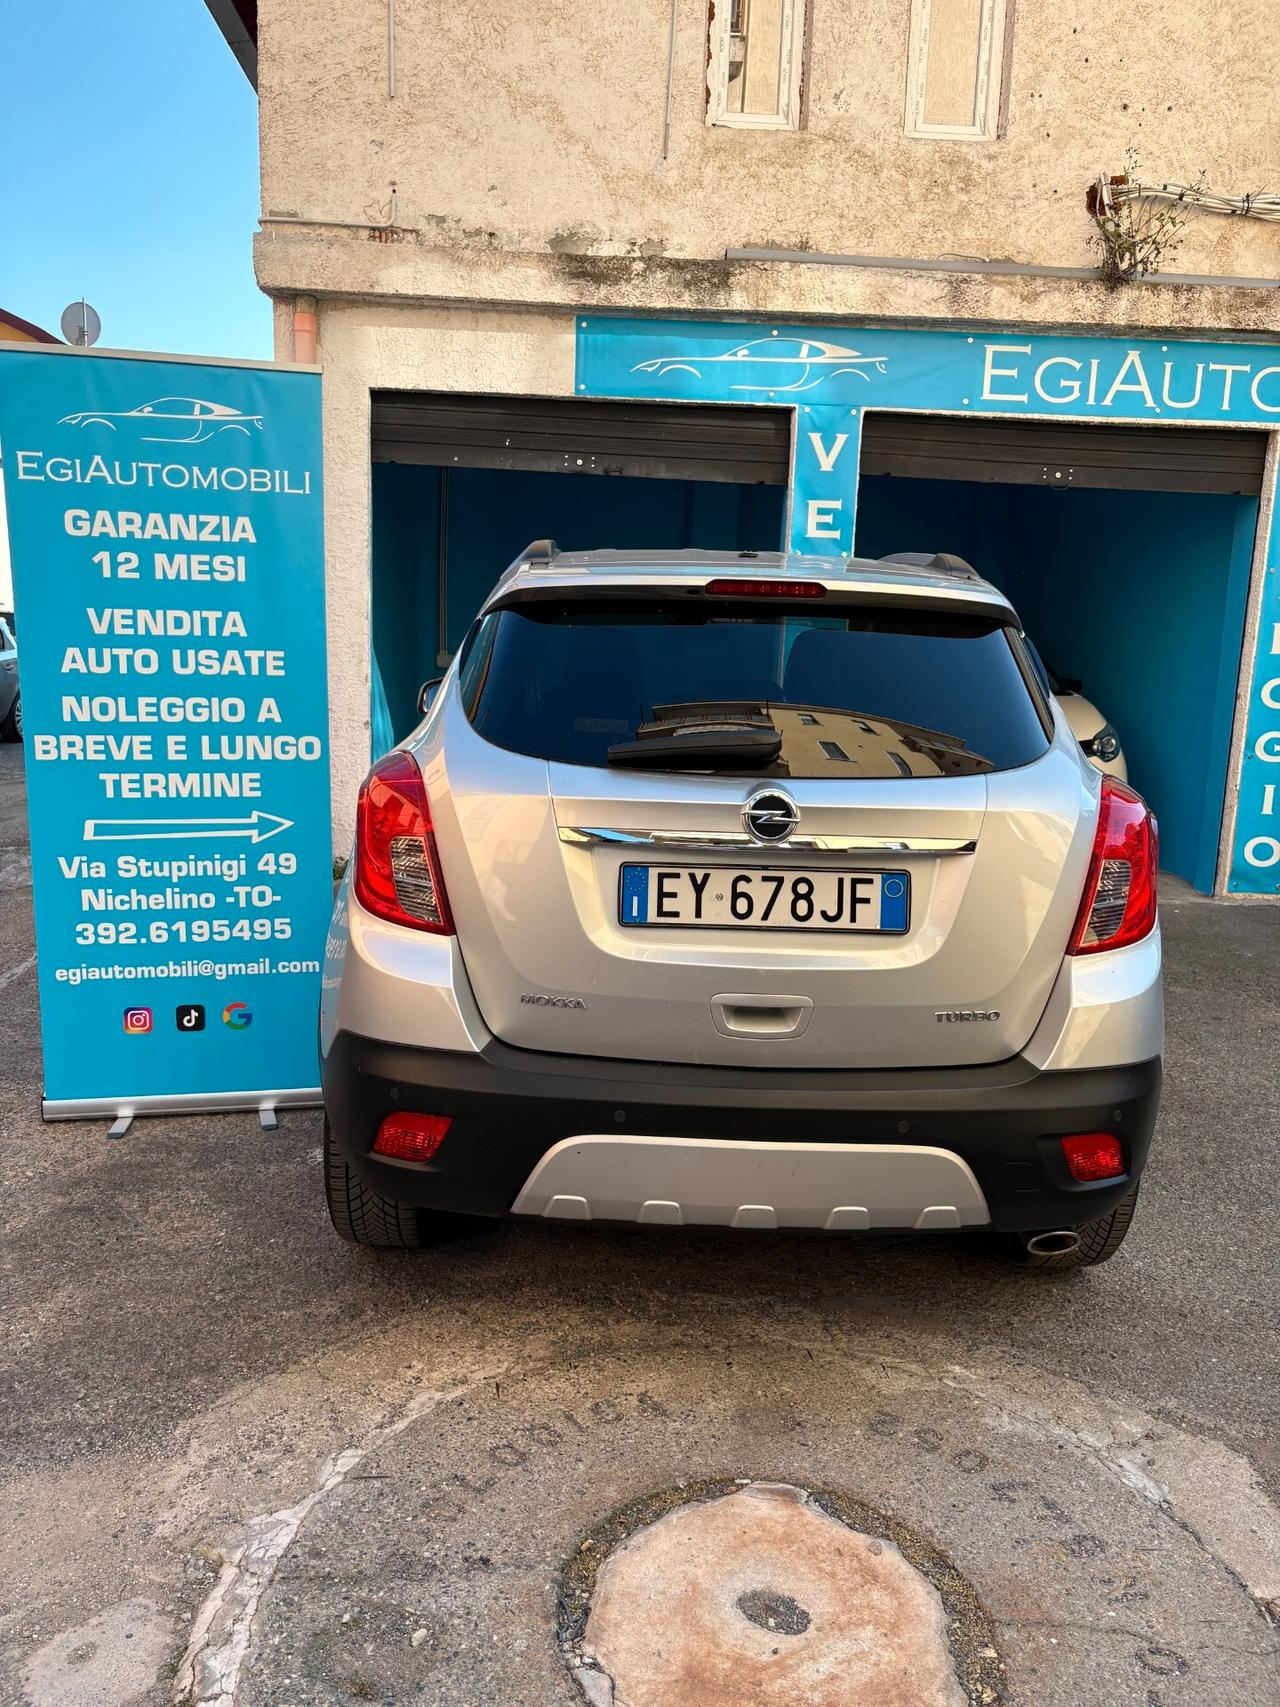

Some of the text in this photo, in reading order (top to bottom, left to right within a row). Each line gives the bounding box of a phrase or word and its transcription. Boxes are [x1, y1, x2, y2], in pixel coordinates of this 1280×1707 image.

[16, 451, 311, 494] EGIAUTOMOBILI
[65, 510, 256, 542] GARANZIA
[93, 552, 245, 581] 12 MESI
[87, 608, 247, 636] VENDITA
[61, 648, 284, 675] AUTO USATE
[63, 697, 281, 722] NOLEGGIO A
[35, 735, 320, 760] BREVE E LUNGO
[99, 773, 261, 798] TERMINE
[58, 853, 296, 882] Via Stupinigi 49
[82, 886, 280, 910] Nichelino -TO-
[656, 872, 711, 919] EY
[76, 919, 291, 944] 392.6195495
[56, 959, 319, 984] egiautomobili@gmail.com
[520, 993, 587, 1009] MOKKA
[934, 1010, 1000, 1023] TURBO
